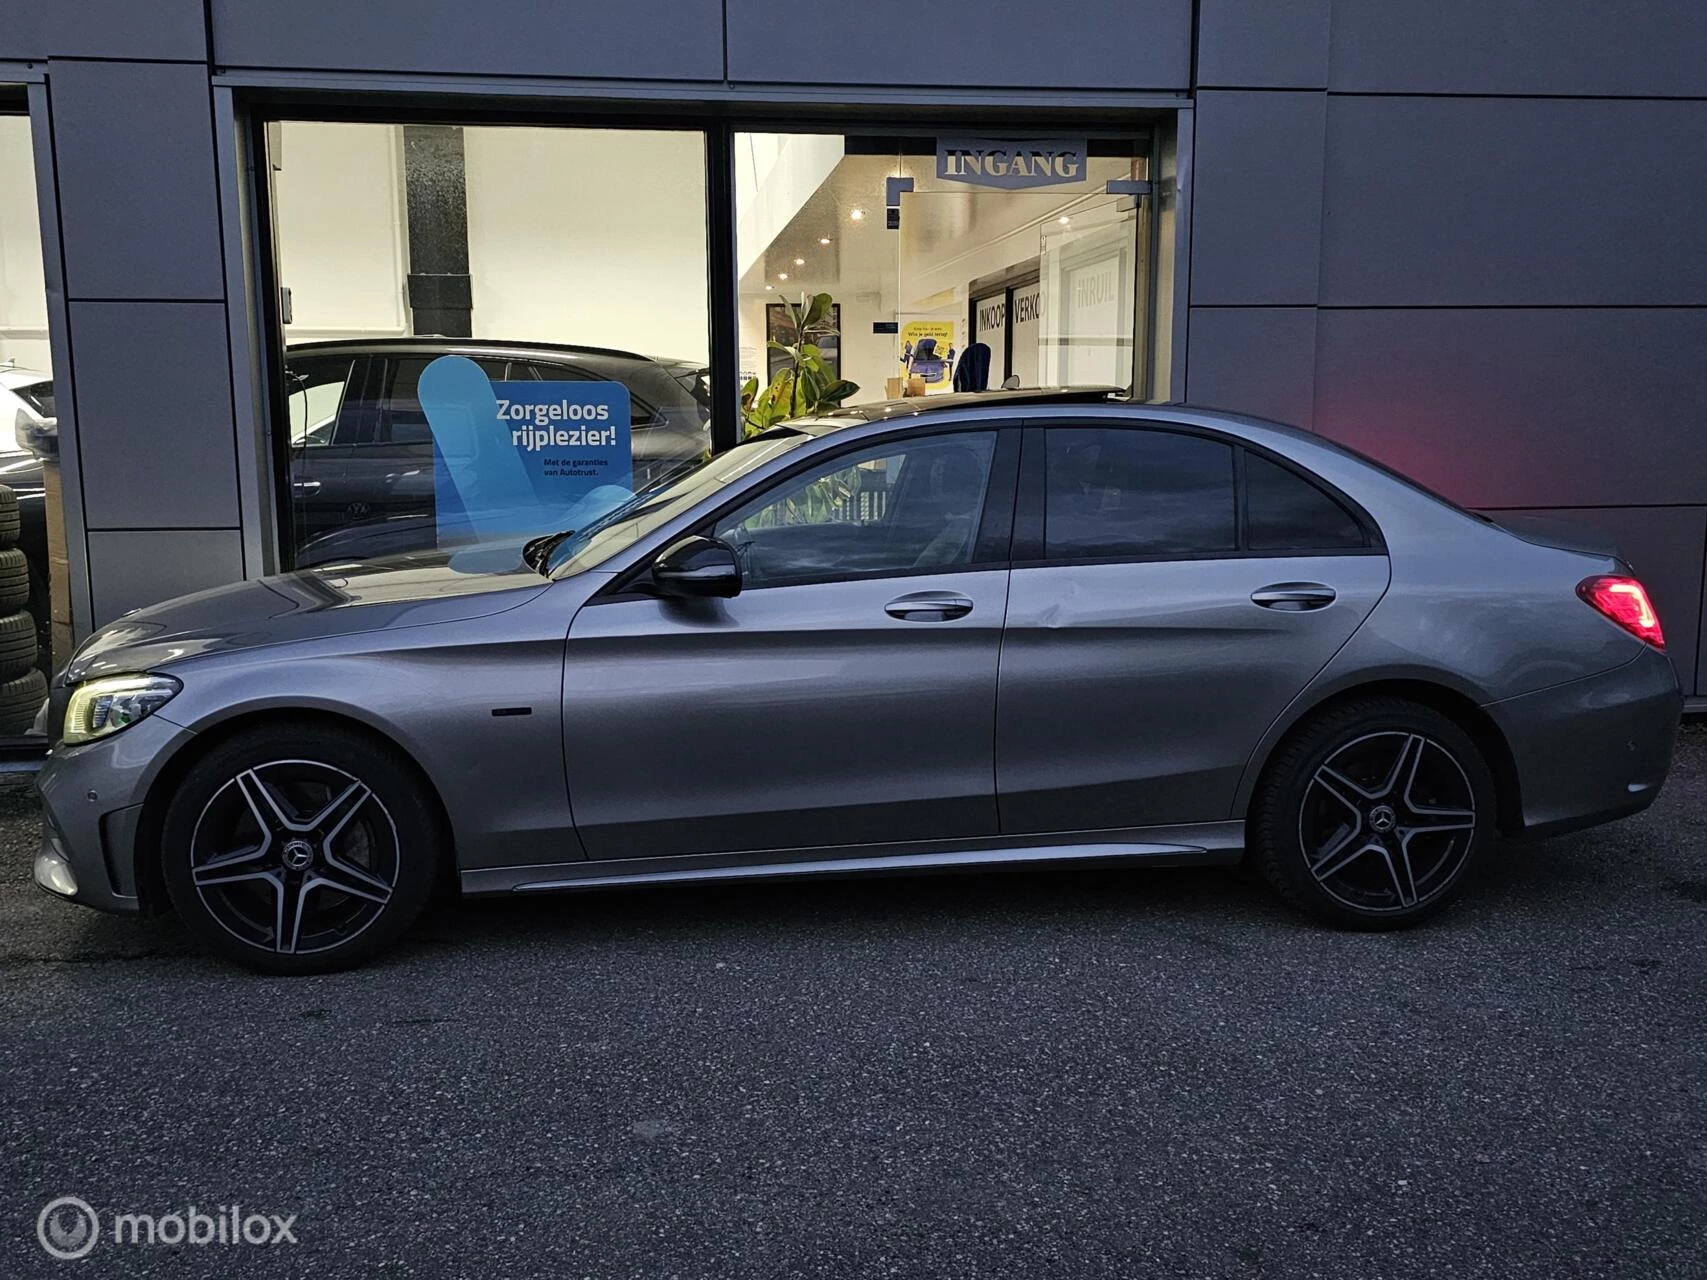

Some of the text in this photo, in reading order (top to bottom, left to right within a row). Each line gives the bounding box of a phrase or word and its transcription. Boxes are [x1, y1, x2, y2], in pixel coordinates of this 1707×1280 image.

[944, 149, 1079, 177] INGANG
[979, 303, 1006, 332] INKOOP
[496, 399, 609, 425] Zorgeloos
[512, 425, 616, 451] rijplezier!
[544, 458, 609, 468] Met de garanties
[560, 468, 599, 477] Autotrust.
